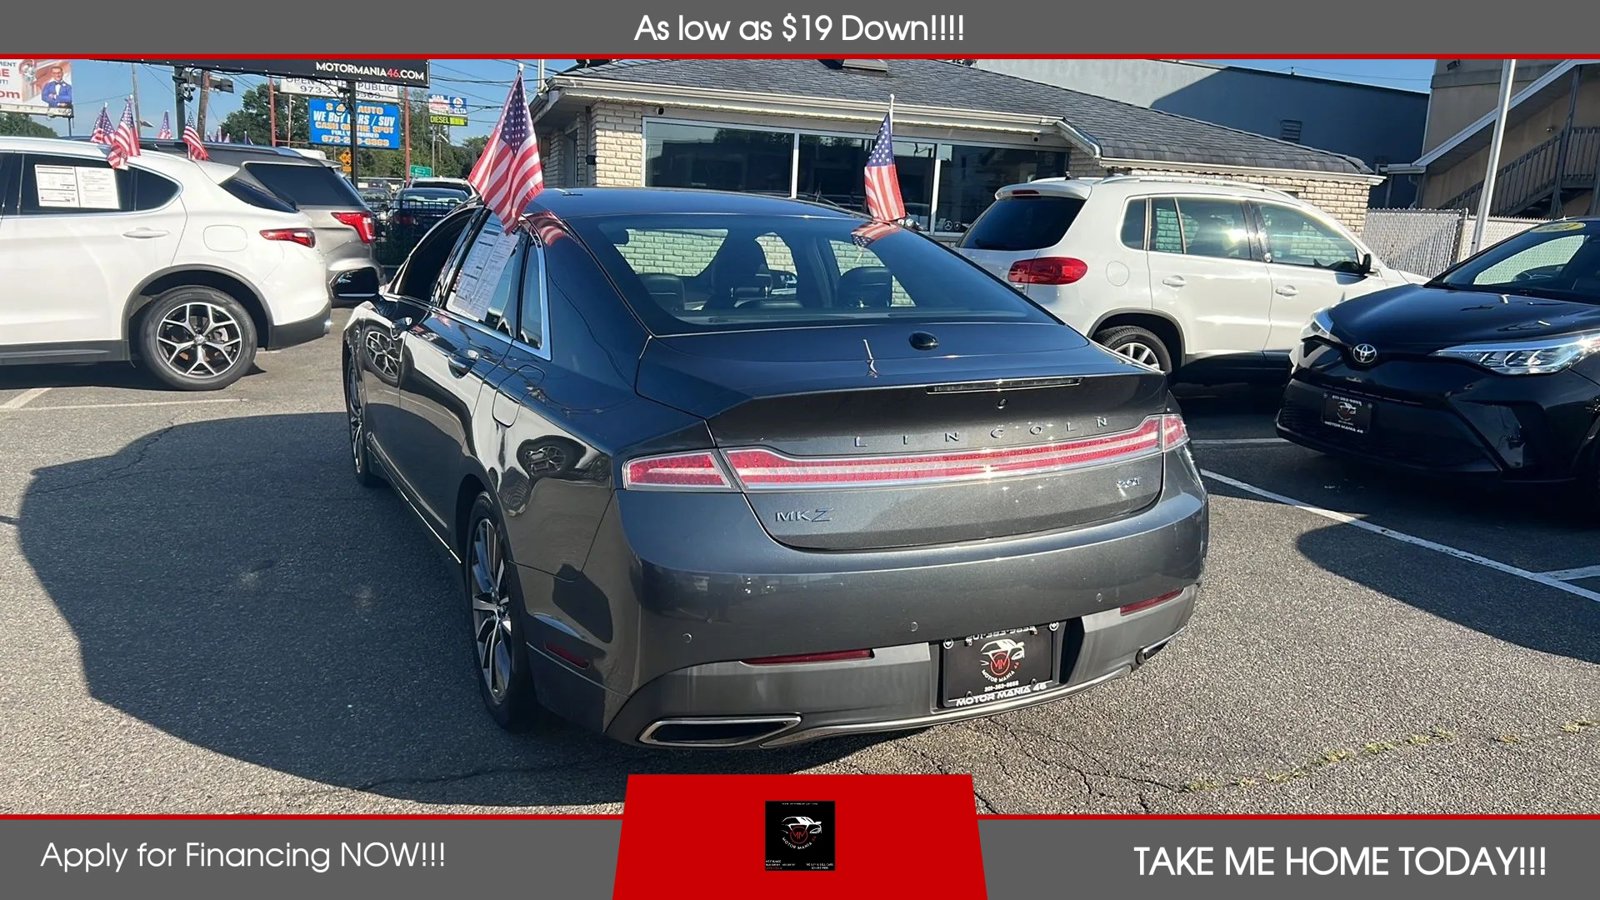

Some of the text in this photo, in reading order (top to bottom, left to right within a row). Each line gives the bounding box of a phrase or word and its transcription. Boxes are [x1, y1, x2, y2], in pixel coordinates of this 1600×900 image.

[316, 61, 425, 81] MOTORMANIA46.COM
[357, 81, 394, 92] PUBLIC
[313, 110, 326, 122] WE
[378, 116, 396, 127] SUV
[430, 115, 450, 124] DIESEL
[854, 416, 1108, 448] LINCOLN
[775, 507, 834, 523] MKZ
[955, 692, 996, 707] MOTOR
[997, 685, 1031, 699] MANIA
